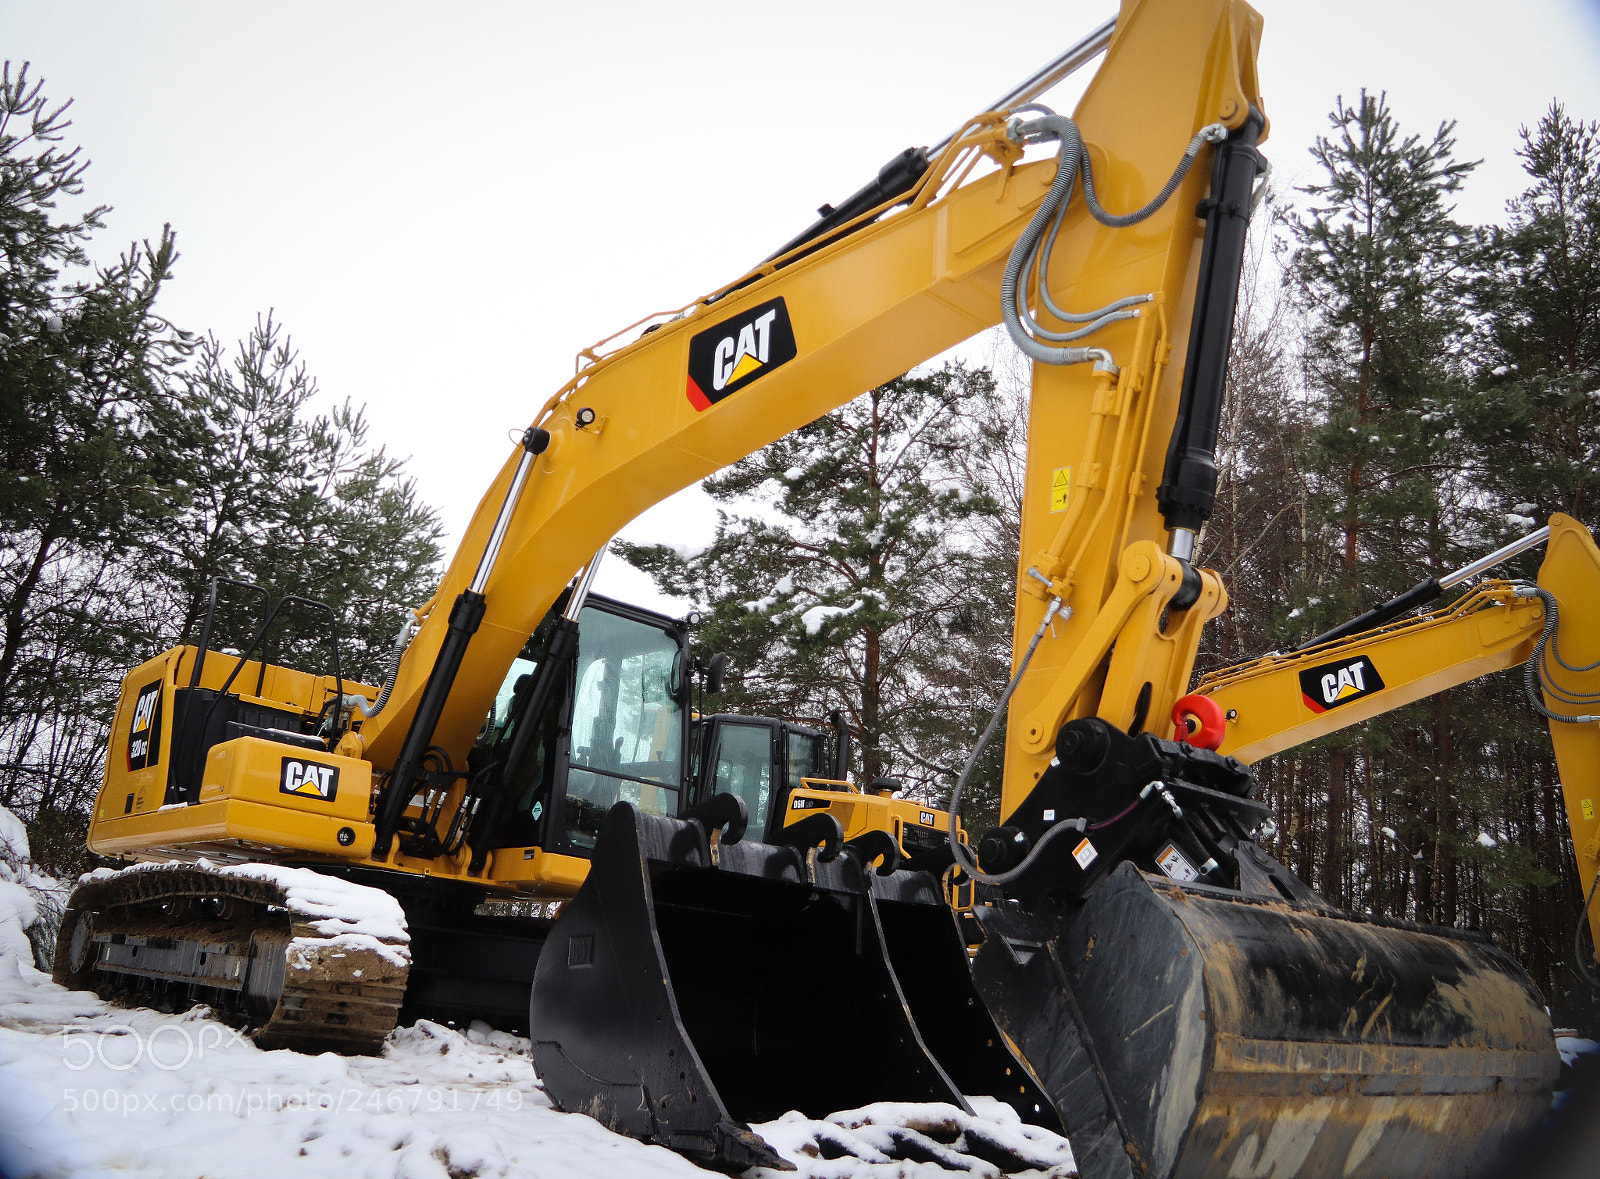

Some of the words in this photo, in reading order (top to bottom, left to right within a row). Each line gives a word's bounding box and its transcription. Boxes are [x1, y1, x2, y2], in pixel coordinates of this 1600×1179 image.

[713, 308, 776, 391] CAT
[1320, 661, 1365, 703] CAT
[133, 690, 158, 733] CAT
[285, 761, 334, 797] CAT
[920, 812, 934, 825] CAT
